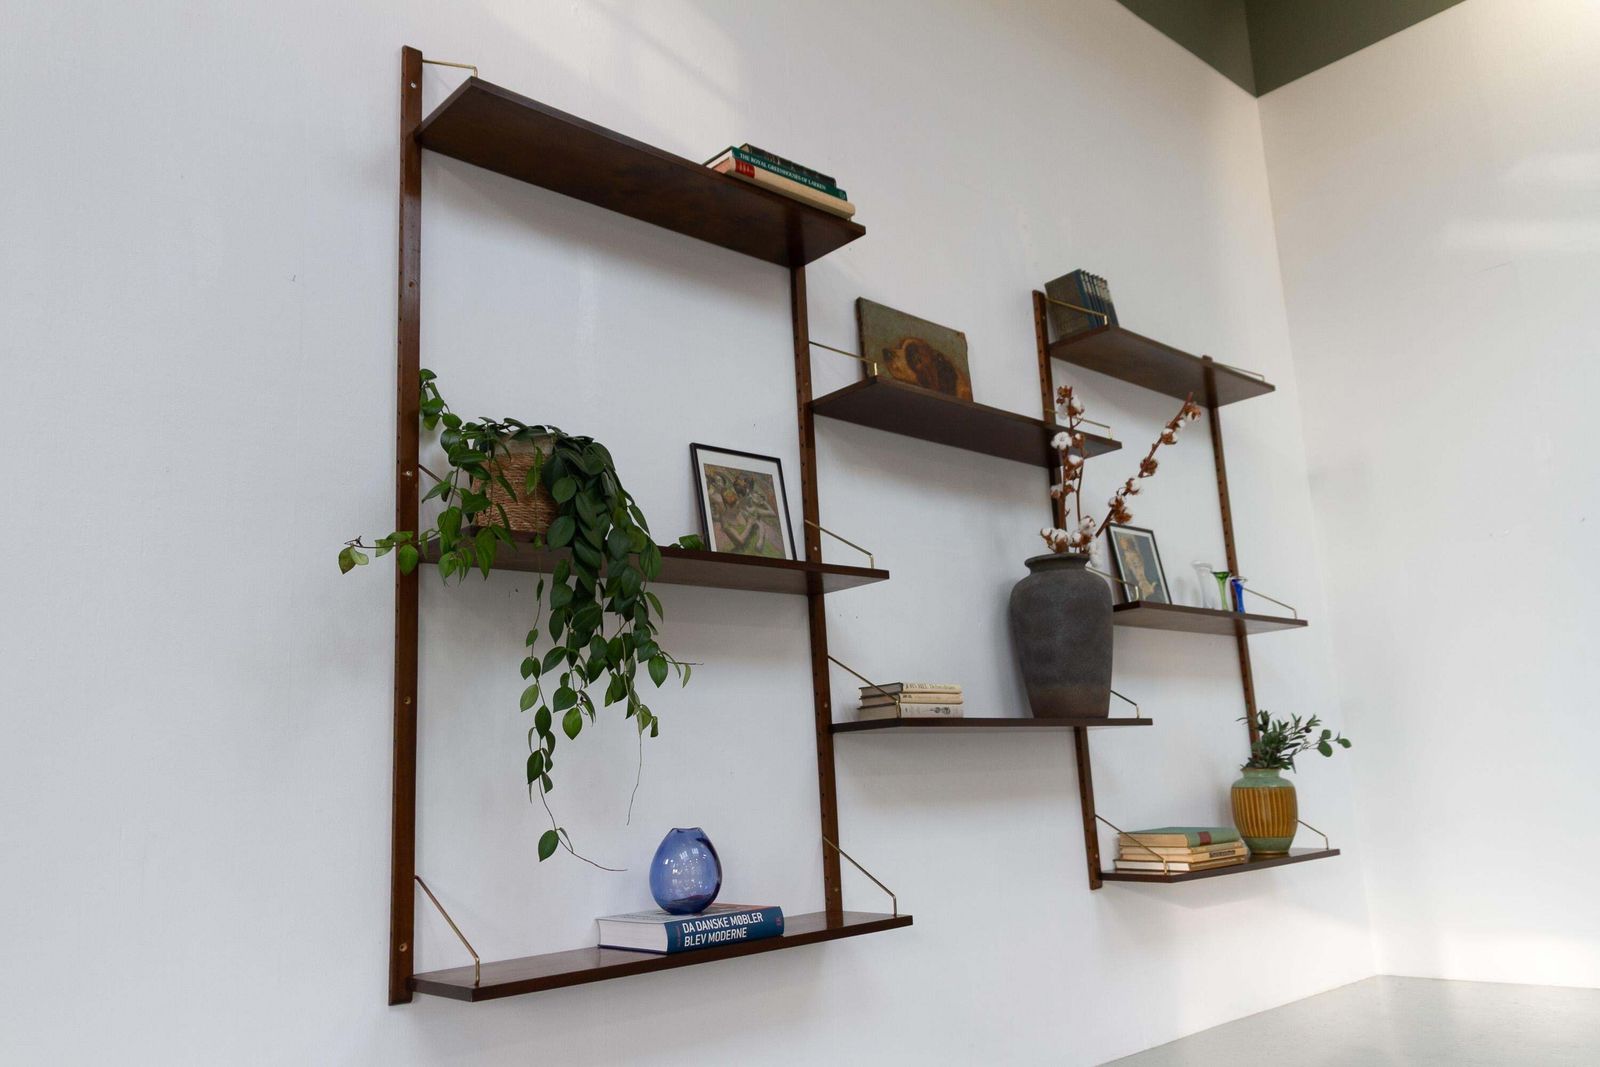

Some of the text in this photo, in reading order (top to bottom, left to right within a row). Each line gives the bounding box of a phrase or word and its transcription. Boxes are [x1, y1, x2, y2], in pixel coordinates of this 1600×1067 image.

[740, 153, 752, 162] THE
[751, 156, 767, 168] ROYAL
[768, 163, 801, 181] GREENHOUSES
[682, 921, 695, 934] DA
[696, 916, 730, 932] DANSKE
[731, 912, 764, 927] MØBLER
[684, 932, 707, 947] BLEV
[708, 927, 748, 943] MODERNE
